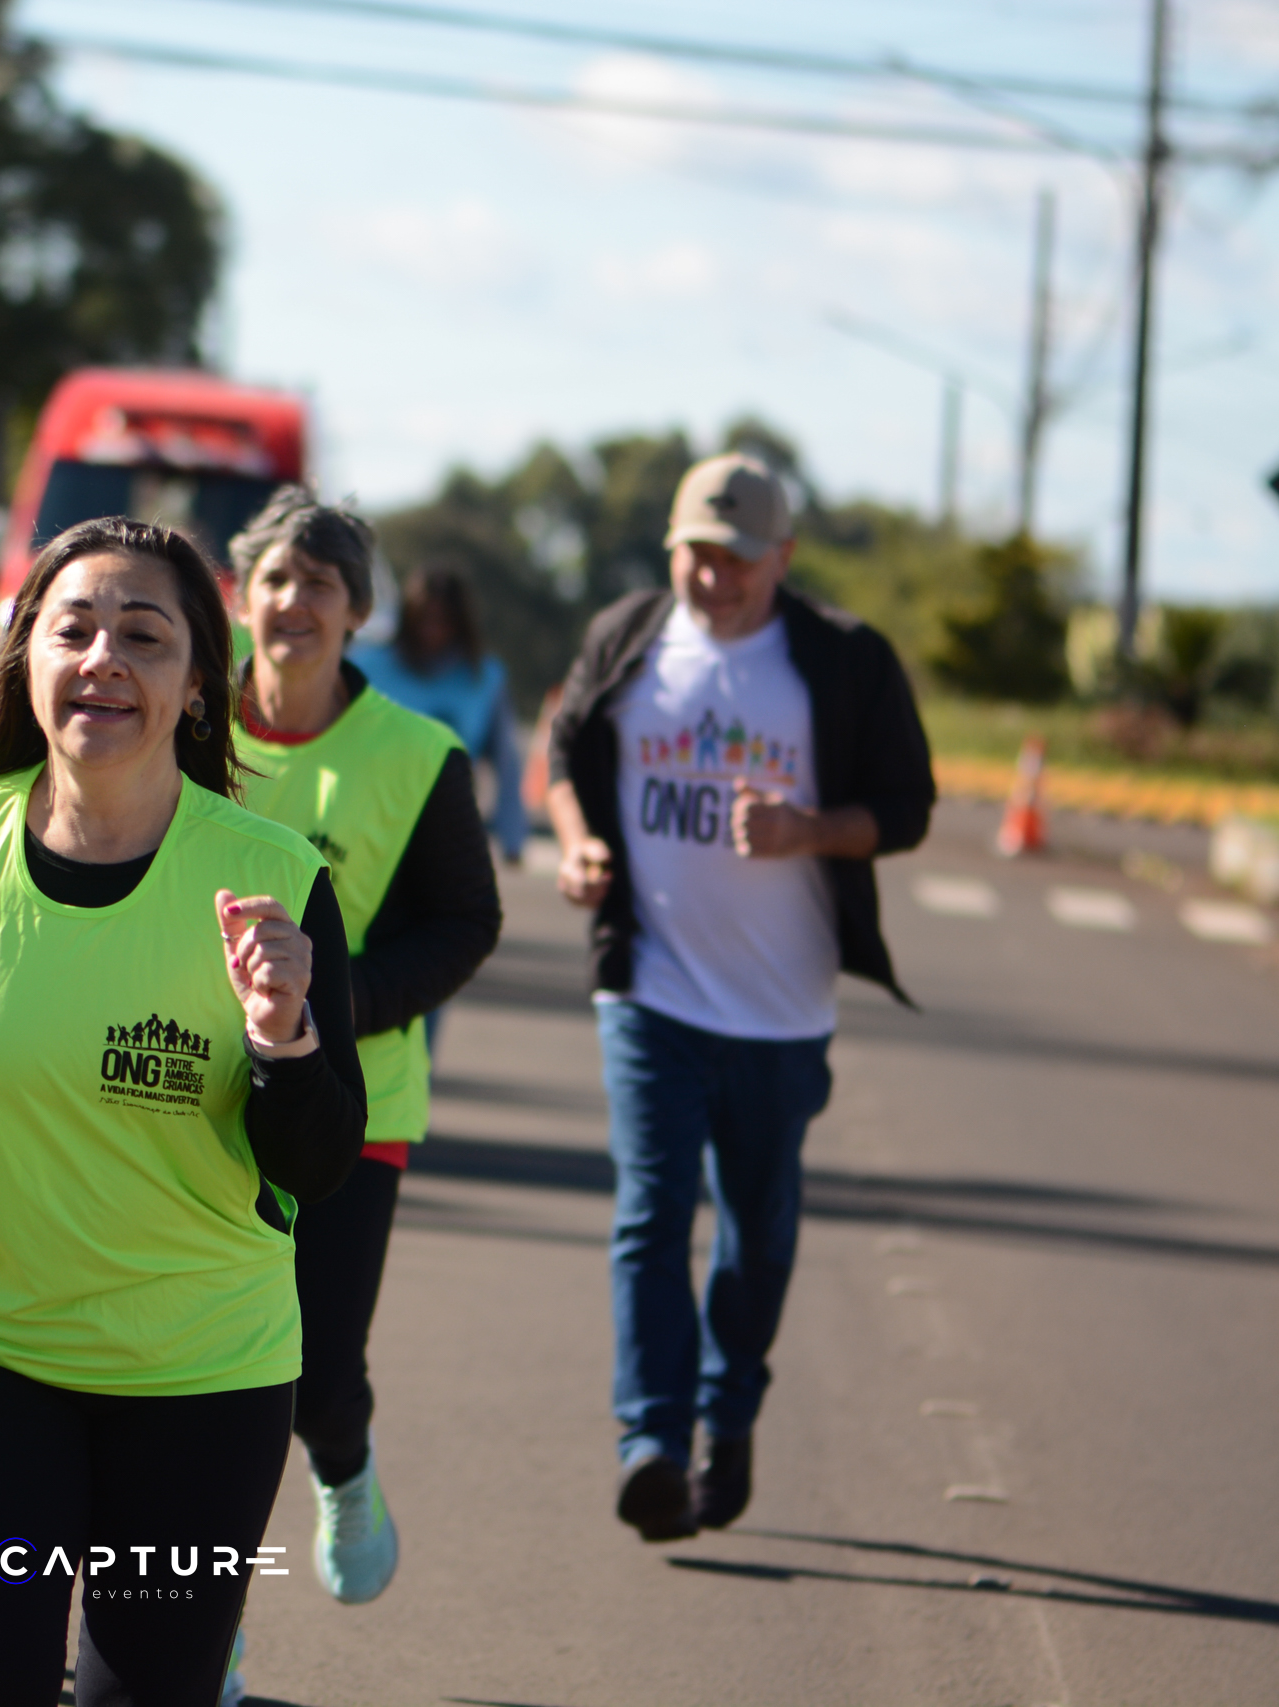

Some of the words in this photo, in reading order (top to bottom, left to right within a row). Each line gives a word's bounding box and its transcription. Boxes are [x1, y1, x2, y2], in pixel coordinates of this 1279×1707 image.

[641, 777, 720, 845] ONG
[101, 1048, 162, 1087] ONG
[165, 1057, 195, 1072] ENTRE
[164, 1069, 198, 1083] AMIGOS
[100, 1084, 106, 1093] A
[107, 1085, 126, 1096] VIDA
[126, 1088, 143, 1099] FICA
[144, 1091, 166, 1103] MAIS
